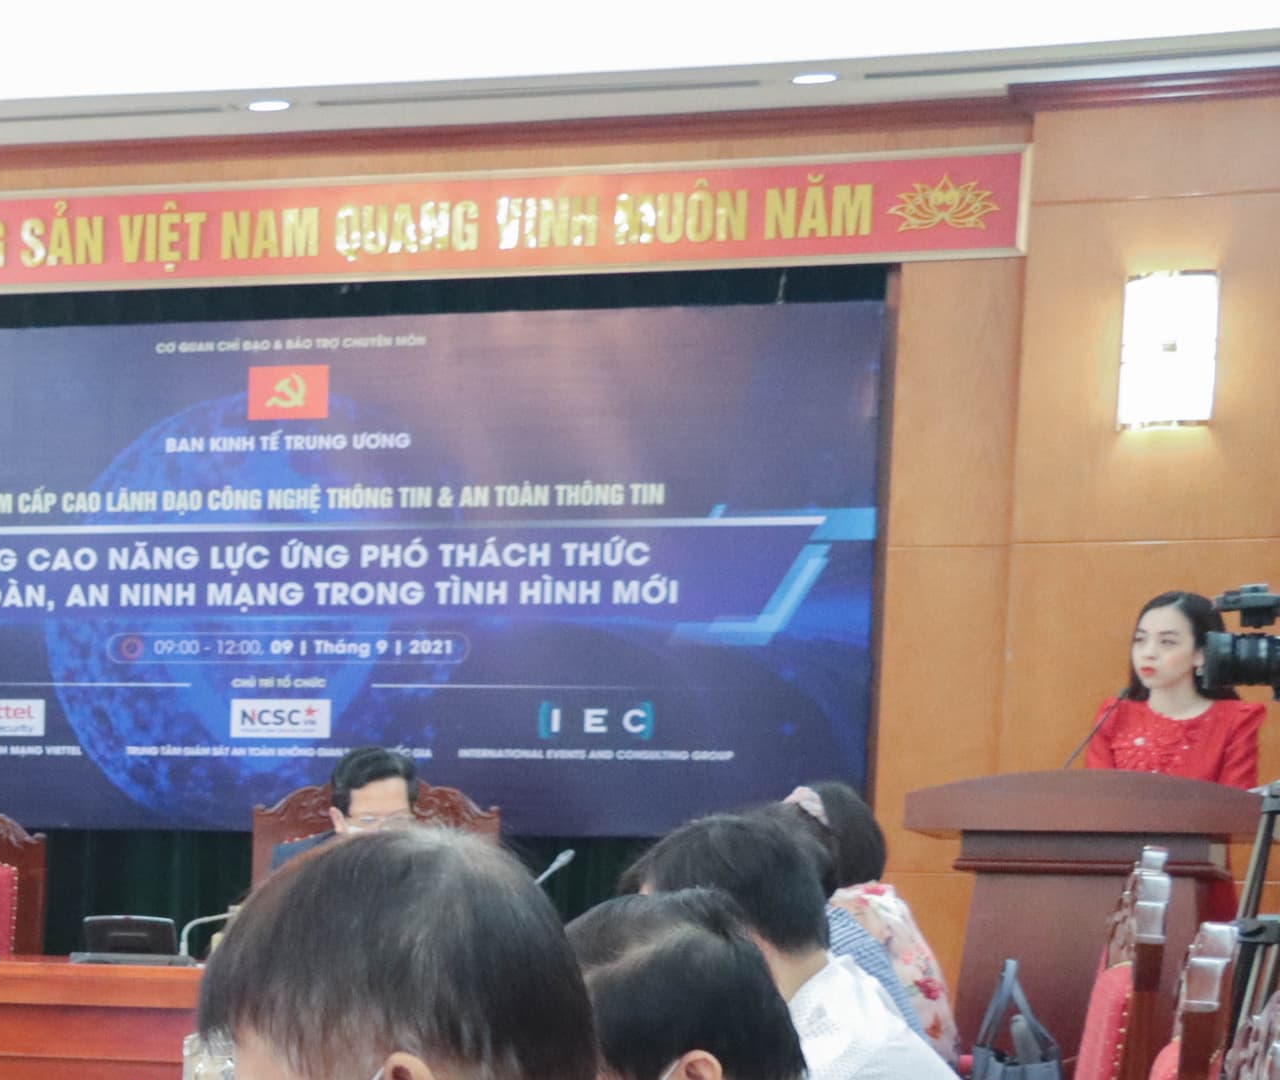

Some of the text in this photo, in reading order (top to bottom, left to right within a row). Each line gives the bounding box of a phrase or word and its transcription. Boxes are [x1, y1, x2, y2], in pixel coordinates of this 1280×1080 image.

[20, 200, 104, 268] SẢN
[119, 201, 207, 273] VIỆT
[220, 206, 320, 261] NAM
[334, 199, 480, 262] QUANG
[496, 193, 601, 252] VINH
[613, 178, 749, 246] MUÔN
[764, 172, 875, 241] NĂM
[165, 429, 412, 453] BAN KINH TẾ TRUNG ƯƠNG
[17, 486, 57, 514] CẤP
[61, 491, 101, 513] CAO
[106, 489, 157, 512] LÃNH
[162, 490, 203, 516] ĐẠO
[207, 486, 262, 511] CÔNG
[267, 484, 321, 513] NGHỆ
[327, 483, 394, 509] THÔNG
[399, 486, 432, 508] TIN
[436, 486, 454, 508] &
[459, 486, 489, 507] AN
[495, 481, 550, 506] TOÀN
[555, 482, 624, 506] THÔNG
[630, 482, 664, 505] TIN
[27, 548, 98, 572] CAO
[108, 541, 200, 571] NĂNG
[209, 543, 271, 576] LỰC
[281, 538, 351, 569] ỨNG
[360, 537, 429, 569] PHÓ
[438, 536, 551, 568] THÁCH
[562, 535, 651, 567] THỨC
[65, 584, 109, 608] AN
[120, 583, 196, 606] NINH
[207, 582, 305, 613] MẠNG
[314, 581, 425, 606] TRONG
[435, 574, 508, 605] TÌNH
[519, 574, 600, 605] HÌNH
[612, 573, 678, 605] MỚI
[153, 639, 200, 656] 09:00
[270, 639, 294, 655] 09
[313, 638, 371, 658] Tháng
[375, 639, 388, 656] 9
[409, 639, 453, 655] 2021
[241, 708, 301, 726] NCSC
[550, 708, 647, 733] IEC
[45, 745, 82, 756] VIETTEL
[457, 748, 544, 759] INTERNATIONAL
[545, 749, 587, 760] EVENTS
[588, 750, 614, 760] AND
[691, 750, 735, 761] GROUP
